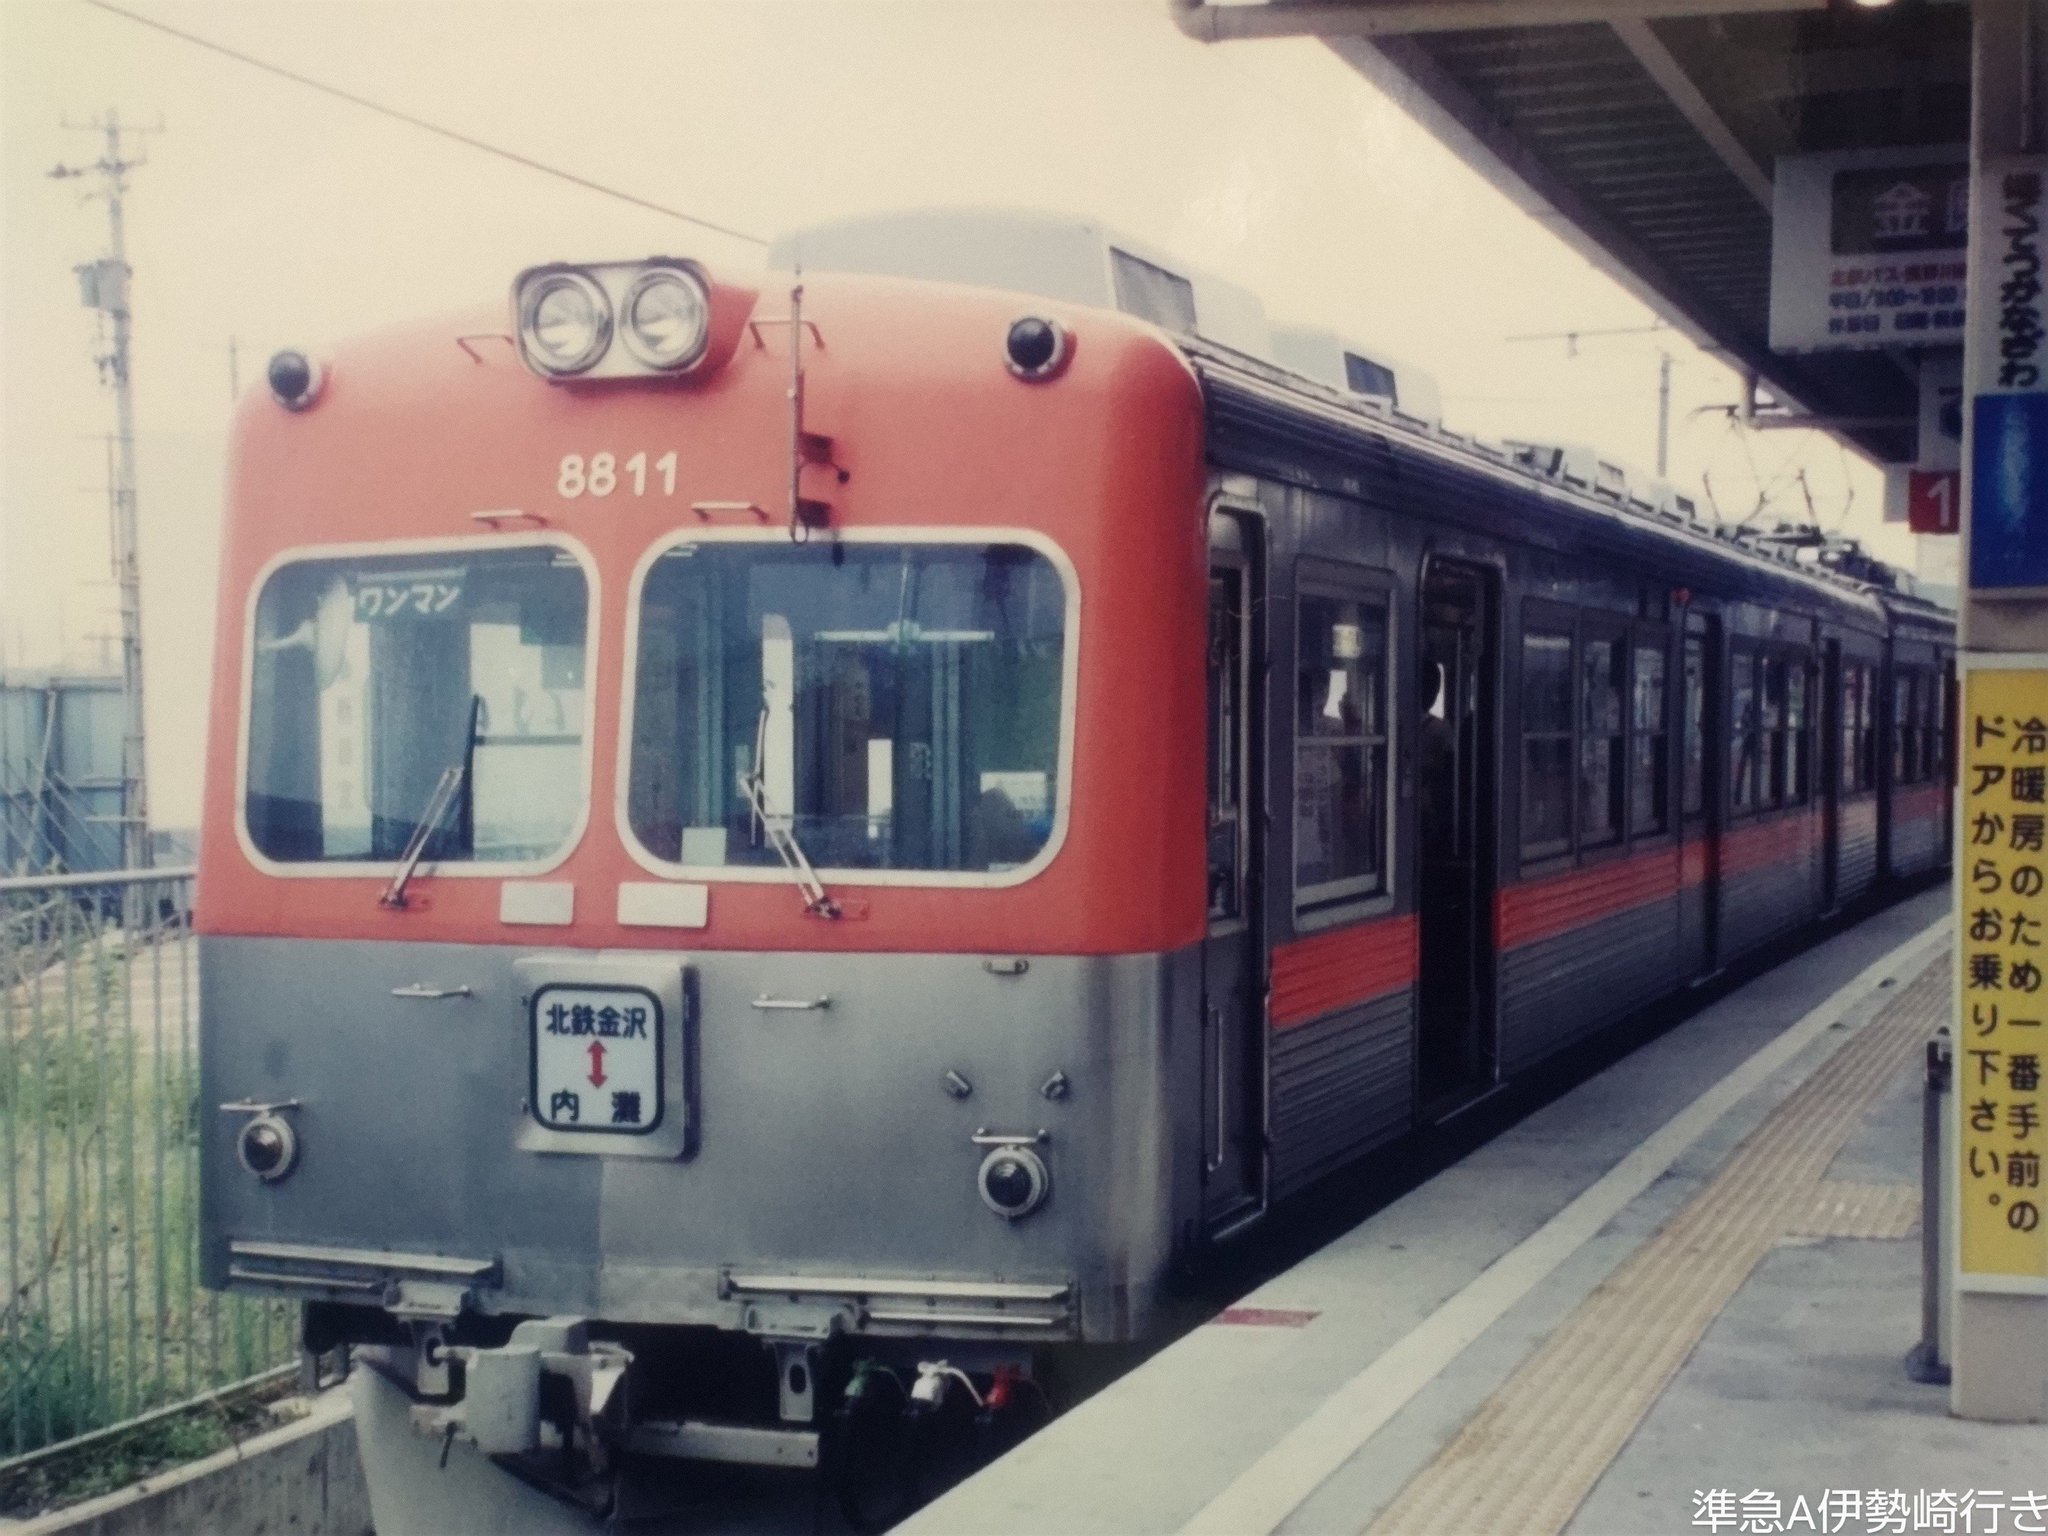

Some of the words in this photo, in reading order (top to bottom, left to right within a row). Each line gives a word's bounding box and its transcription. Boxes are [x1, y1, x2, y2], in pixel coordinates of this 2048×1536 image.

[557, 452, 678, 498] 8811
[1927, 478, 1951, 527] 1
[357, 584, 463, 616] ワンマン
[1969, 715, 2005, 1208] ドアからお乗り下さい。
[2007, 716, 2047, 1234] 冷暖房のため一番手前の
[546, 1003, 647, 1039] 北鉄金沢
